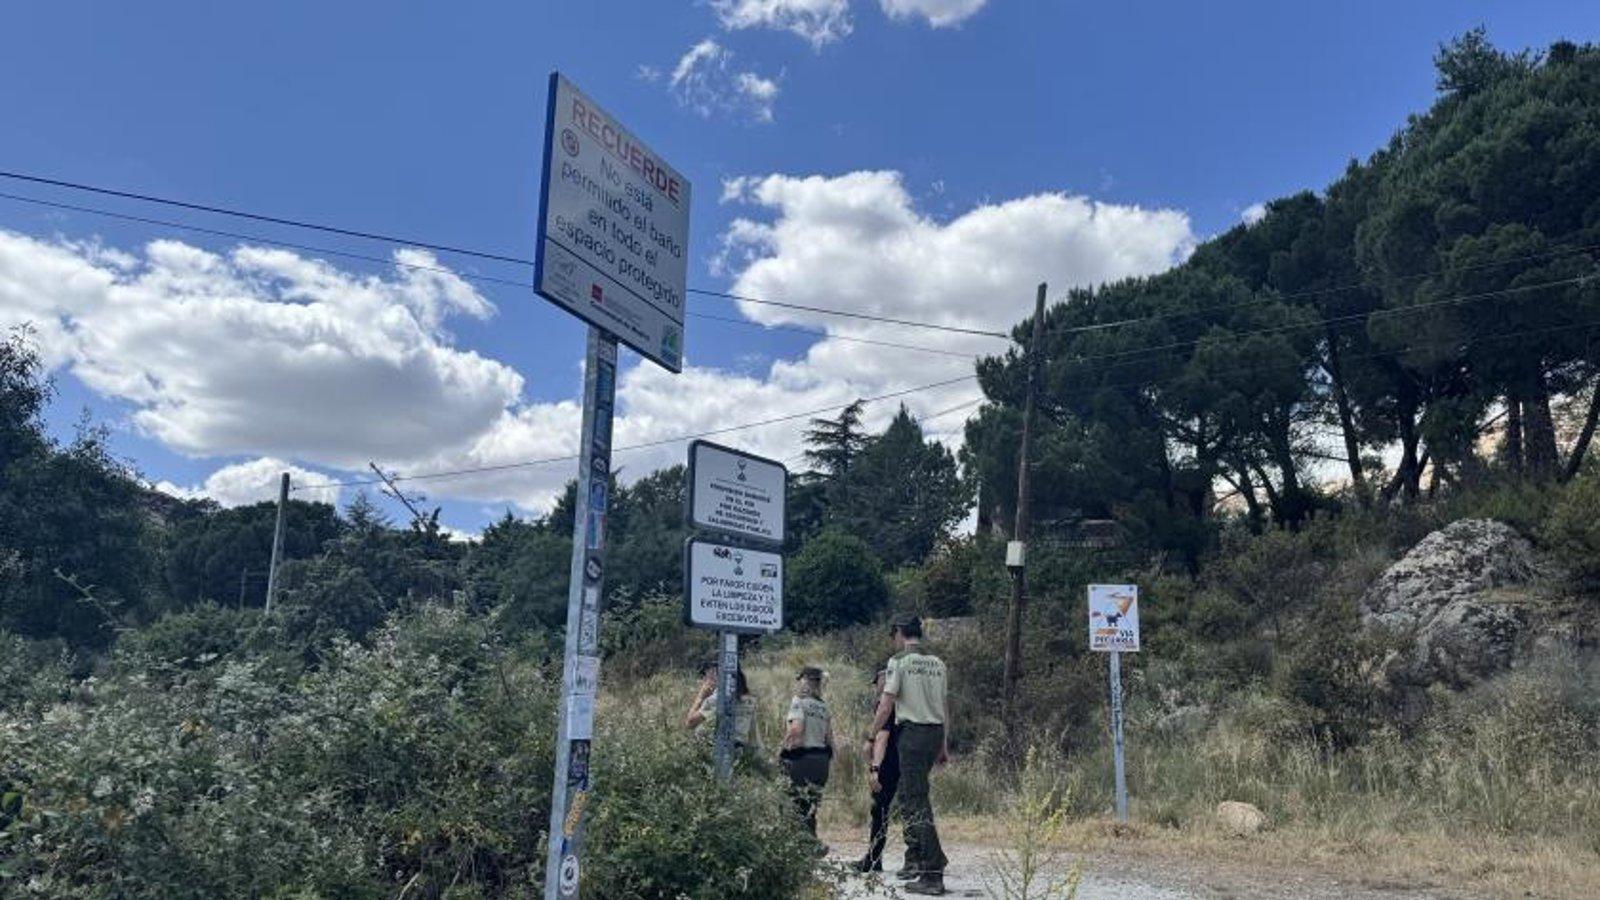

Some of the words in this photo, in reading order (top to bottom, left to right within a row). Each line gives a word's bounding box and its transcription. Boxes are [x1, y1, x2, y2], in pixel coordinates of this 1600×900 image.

[572, 97, 679, 204] RECUERDE
[600, 156, 621, 186] No
[562, 162, 631, 220] permitido
[633, 212, 647, 233] el
[650, 224, 681, 259] baño
[589, 209, 607, 233] en
[612, 221, 642, 256] todo
[645, 250, 658, 267] el
[555, 215, 616, 264] espacio
[618, 258, 680, 308] protegido
[701, 576, 718, 586] POR
[719, 579, 745, 589] FAVOR
[712, 589, 722, 598] LA
[729, 602, 745, 612] LOS
